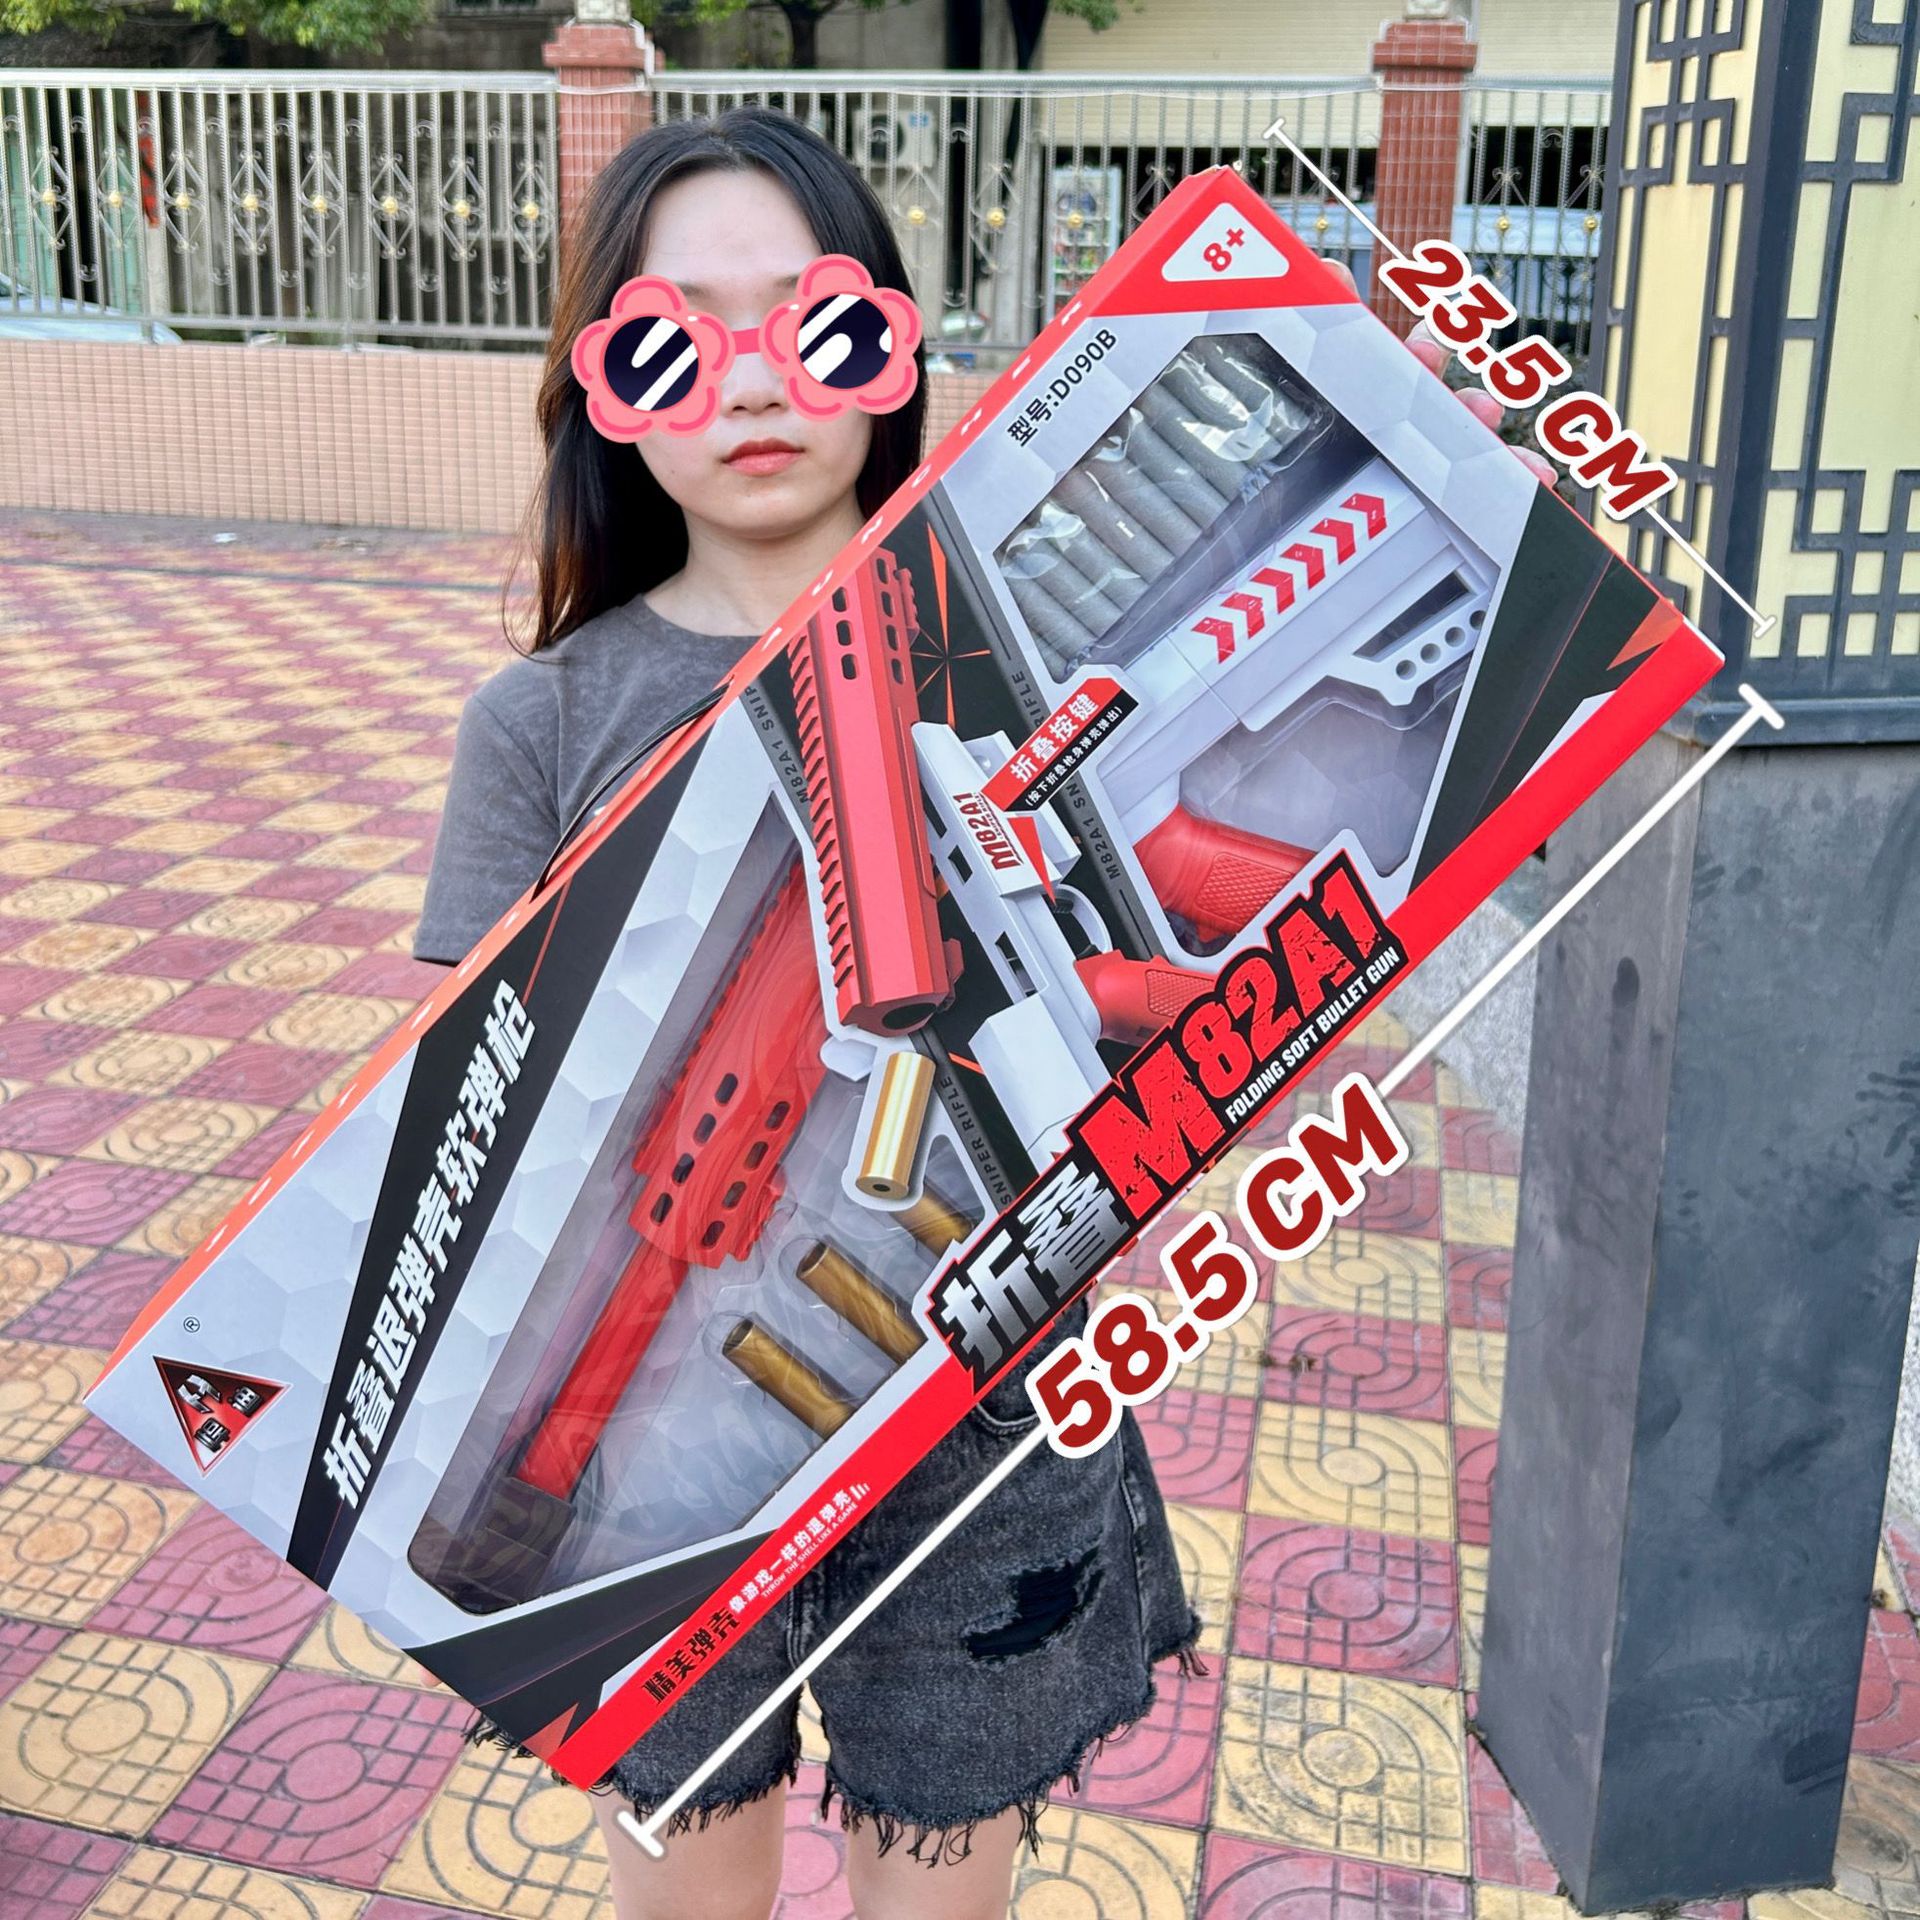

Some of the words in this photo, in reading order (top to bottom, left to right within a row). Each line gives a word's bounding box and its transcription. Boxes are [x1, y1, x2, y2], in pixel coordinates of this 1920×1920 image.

[1203, 228, 1245, 272] 8+
[1007, 328, 1117, 447] 型号:D090B
[1009, 692, 1099, 784] 折叠按键
[952, 792, 1021, 871] M82A1
[1082, 817, 1122, 880] M82A1
[1079, 867, 1383, 1220] M82A1
[1224, 1060, 1286, 1125] FOLDING
[1281, 1024, 1319, 1068] SOFT
[1315, 975, 1369, 1034] BULLET
[1365, 946, 1401, 985] GUN
[940, 1075, 975, 1132] RIFLE
[969, 1137, 1014, 1206] SNIPER
[322, 978, 536, 1510] 折叠退弹壳软弹枪
[940, 1160, 1130, 1374] 折叠
[798, 1542, 819, 1563] SHELL
[837, 1502, 859, 1523] GAME
[641, 1607, 741, 1705] 精美弹壳
